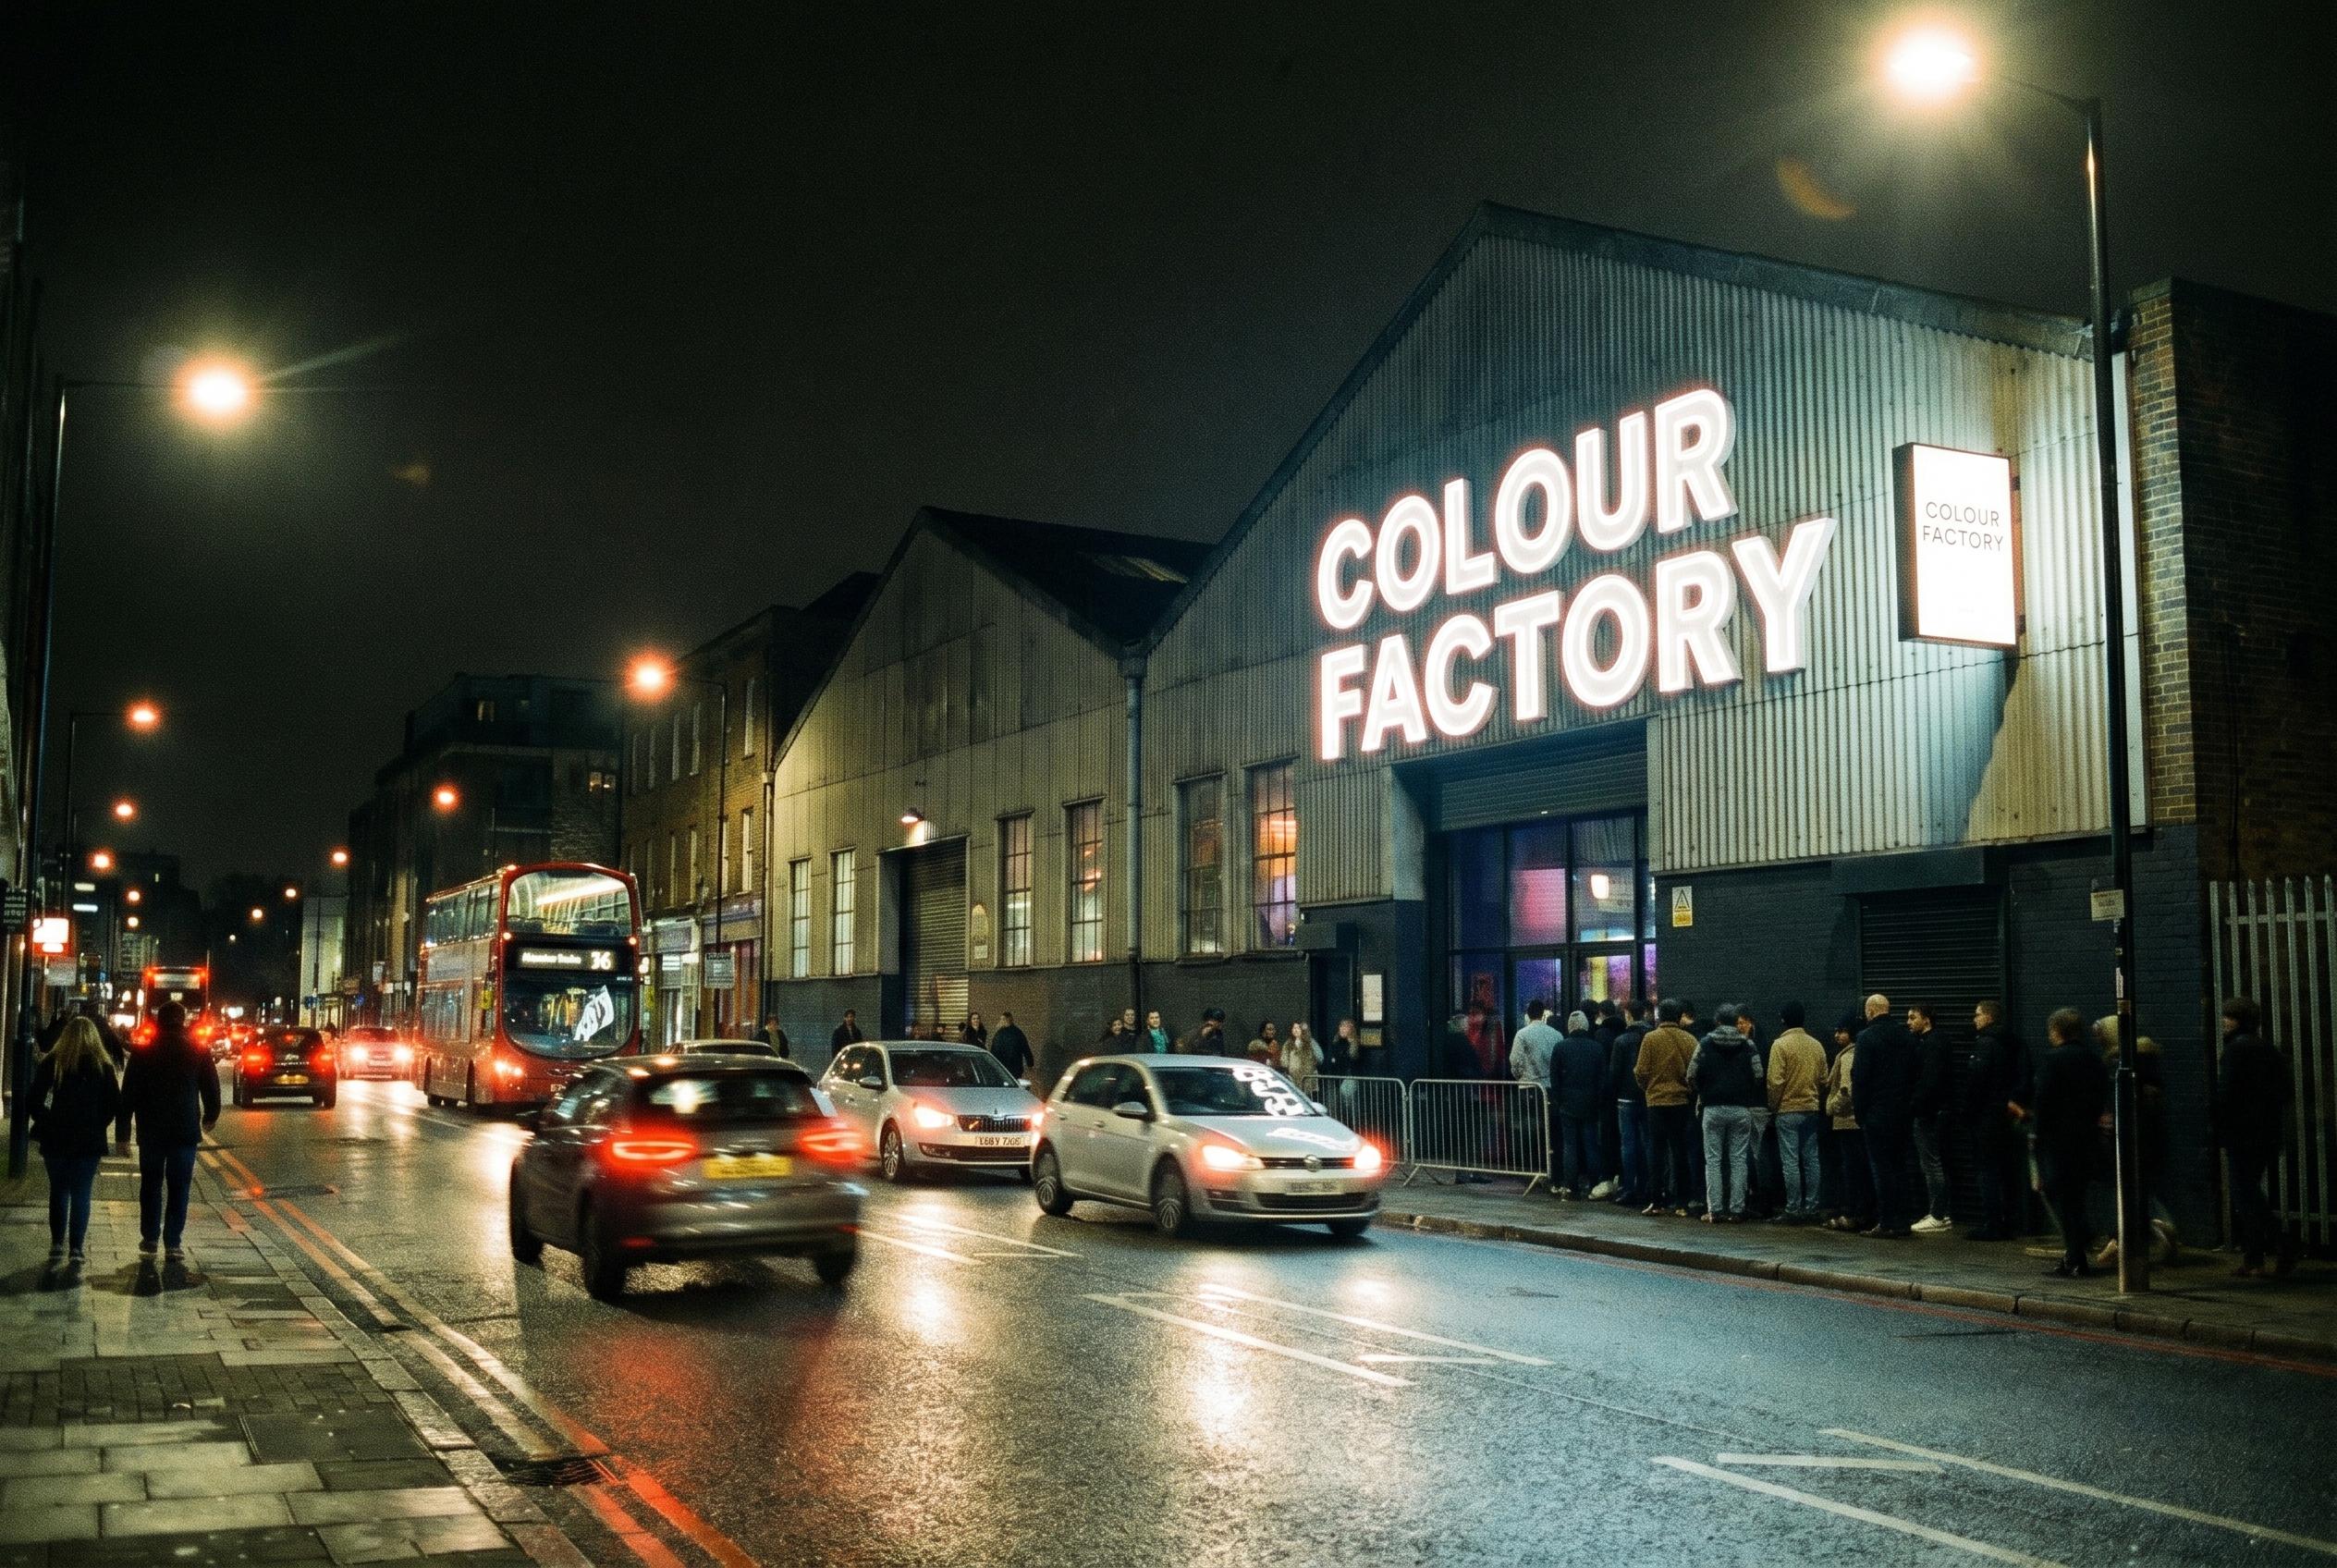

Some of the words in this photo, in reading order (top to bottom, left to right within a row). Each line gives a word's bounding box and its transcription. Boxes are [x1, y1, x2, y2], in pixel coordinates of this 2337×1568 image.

[1317, 388, 1739, 630] COLOUR
[1926, 501, 2000, 527] COLOUR
[1923, 525, 2004, 551] FACTORY
[1319, 517, 1837, 760] FACTORY
[591, 950, 612, 970] 36
